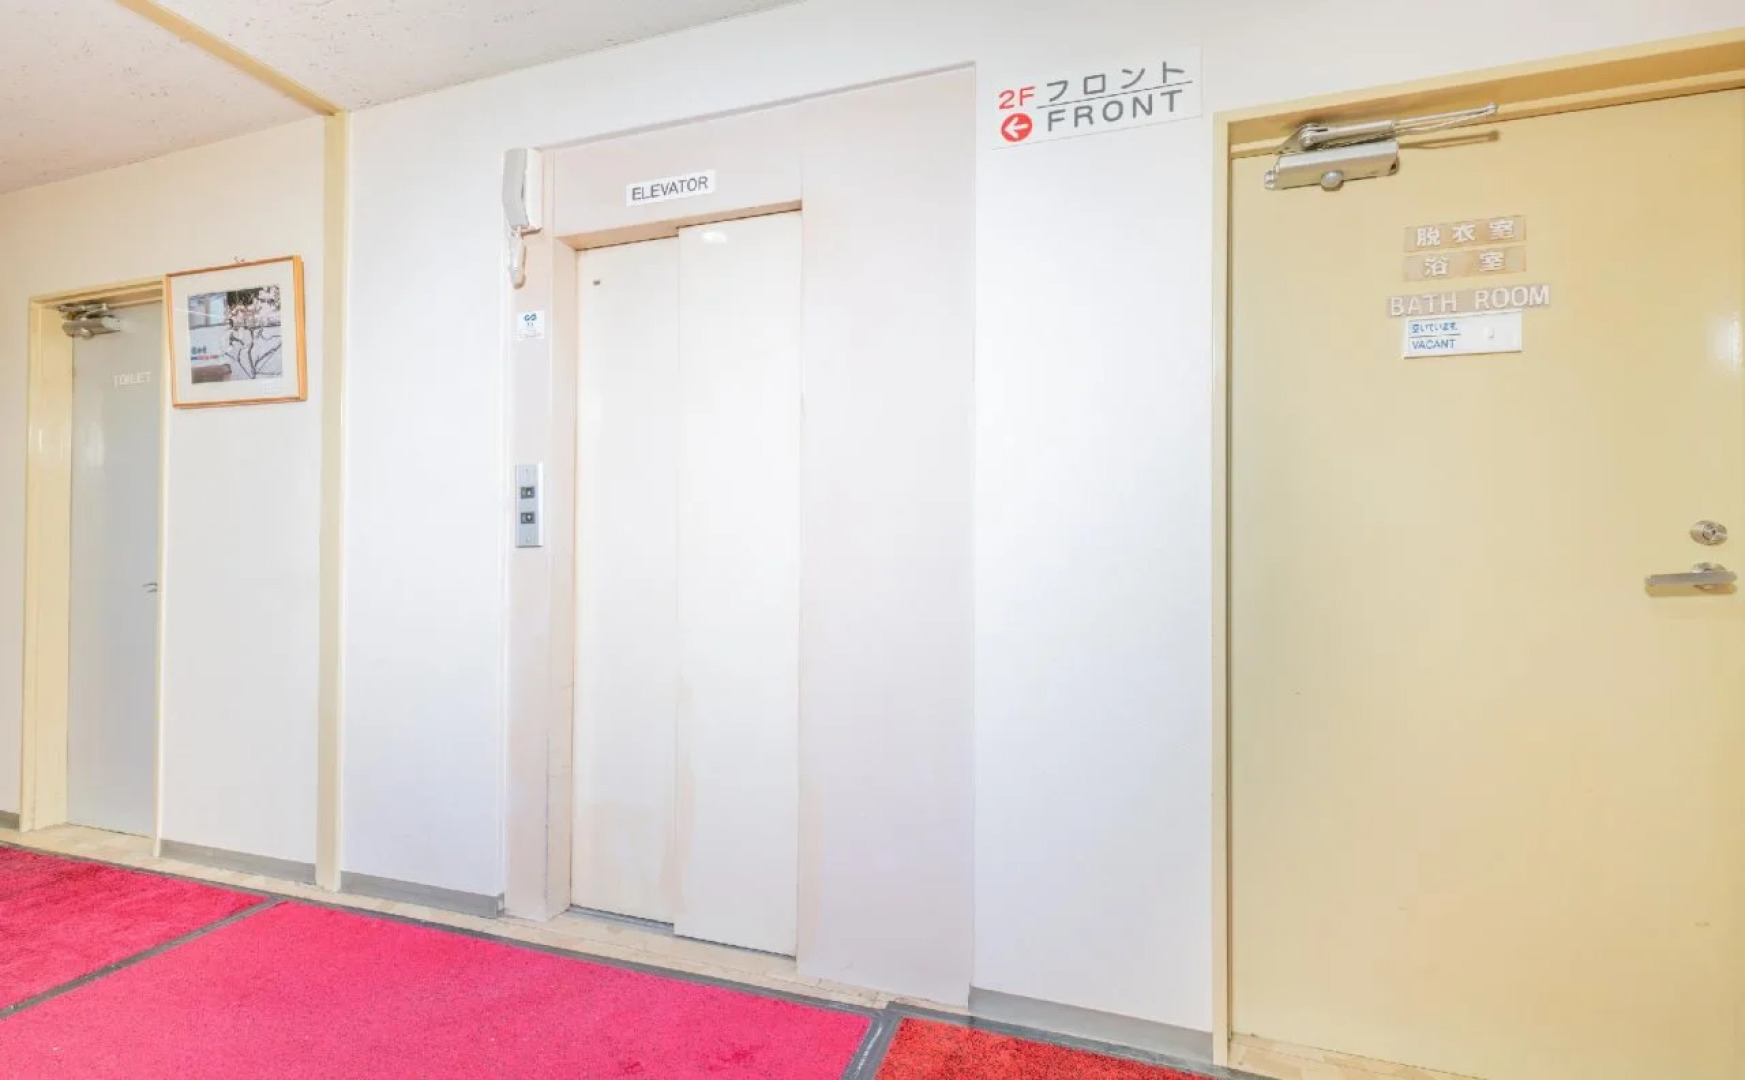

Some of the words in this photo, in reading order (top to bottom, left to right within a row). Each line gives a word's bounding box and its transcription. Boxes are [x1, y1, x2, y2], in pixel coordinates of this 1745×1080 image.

[1046, 61, 1185, 102] フロント
[998, 85, 1036, 110] 2F
[1047, 88, 1183, 132] FRONT
[632, 175, 709, 201] ELEVATOR
[1416, 219, 1514, 247] 脱衣室
[1424, 251, 1505, 276] 浴室
[1391, 292, 1457, 316] BATH
[1475, 285, 1550, 310] ROOM
[1411, 338, 1457, 350] VACANT
[112, 371, 152, 389] TOILET
